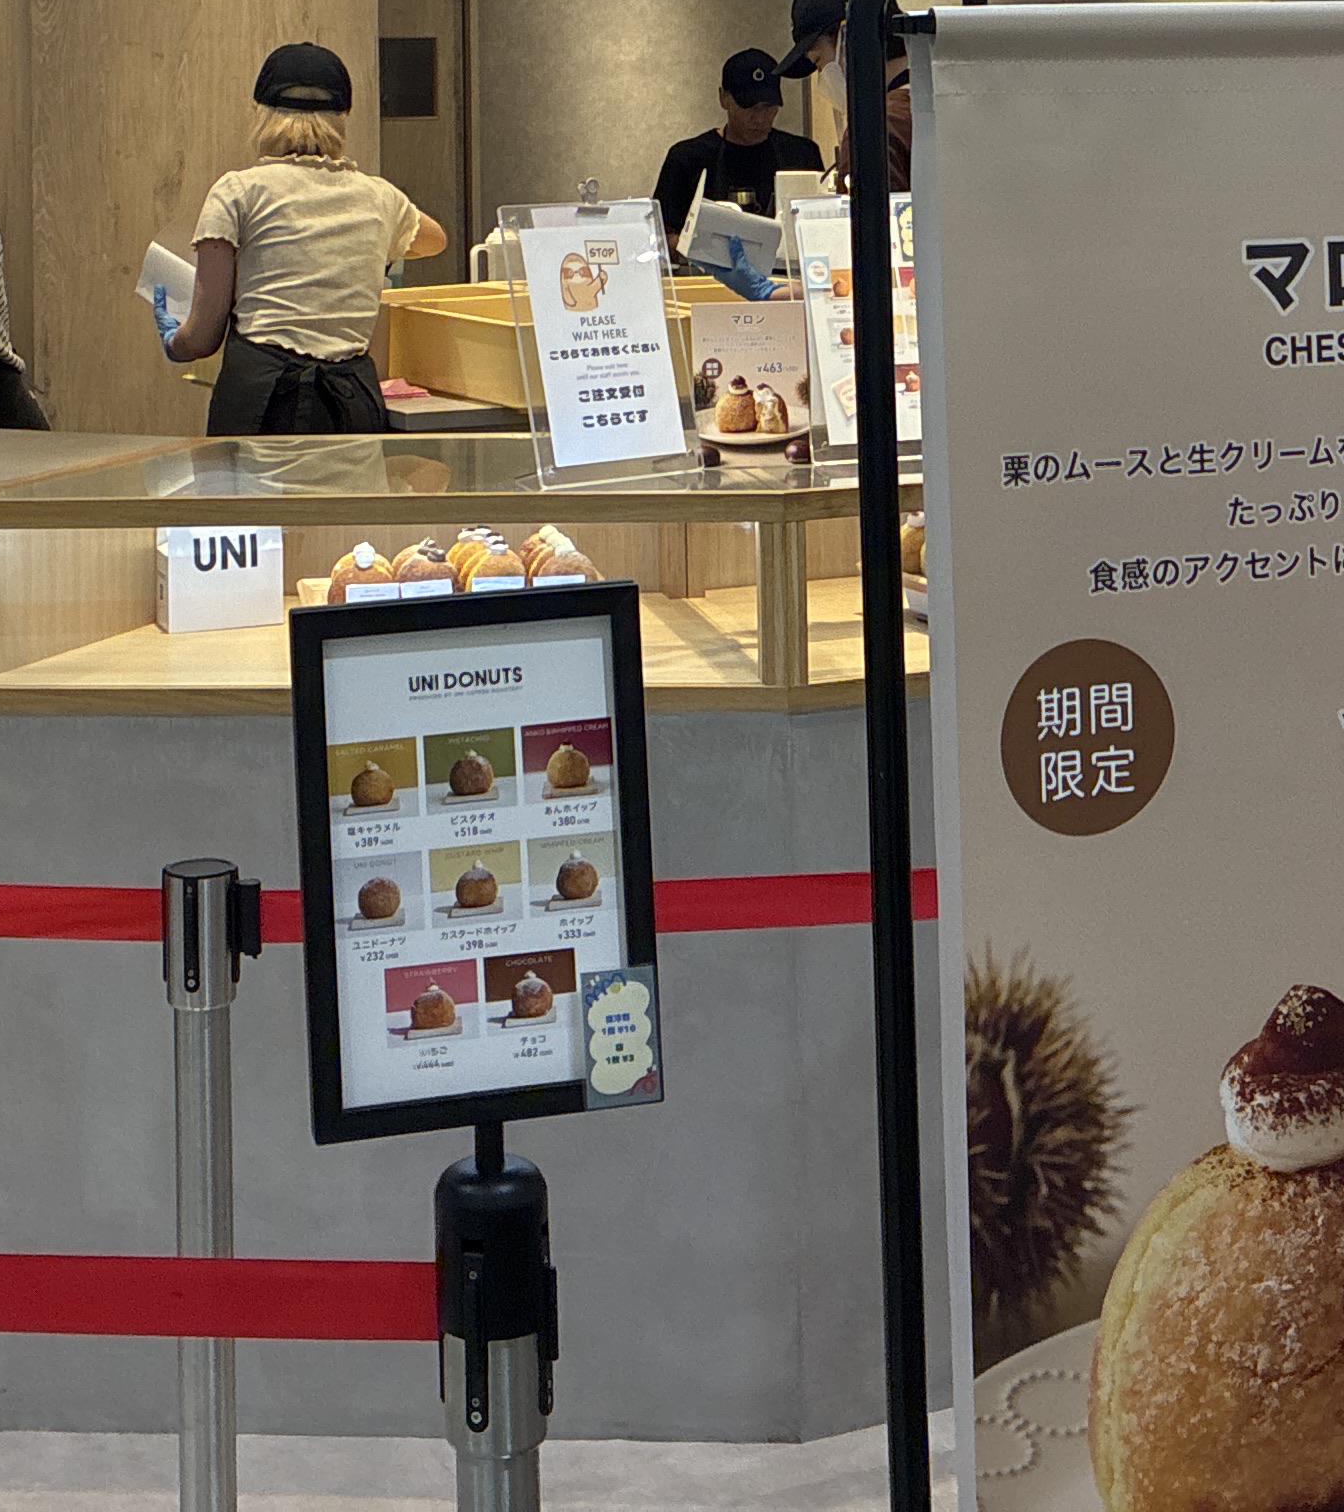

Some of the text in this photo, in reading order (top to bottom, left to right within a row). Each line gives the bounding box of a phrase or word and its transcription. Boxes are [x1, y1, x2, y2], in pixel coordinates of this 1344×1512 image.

[589, 247, 615, 259] STOP
[580, 315, 616, 327] PLEASE
[731, 315, 765, 325] マロン
[572, 328, 628, 342] WAIT HERE
[549, 342, 661, 361] こちらでお待ちください
[578, 384, 645, 403] ご注文受付
[582, 409, 648, 428] こちらです
[193, 534, 258, 572] UNI
[408, 666, 523, 692] UNI DONUTS
[1037, 682, 1134, 742] 期間
[335, 743, 405, 757] SALTED CARAMEL
[1039, 746, 1136, 804] 限定
[544, 801, 598, 816] あんホイップ
[559, 915, 595, 928] ホイップ
[439, 923, 518, 941] カスタードホイップ
[351, 935, 406, 951] ユニドーナツ
[506, 955, 554, 968] CHOCOLATE
